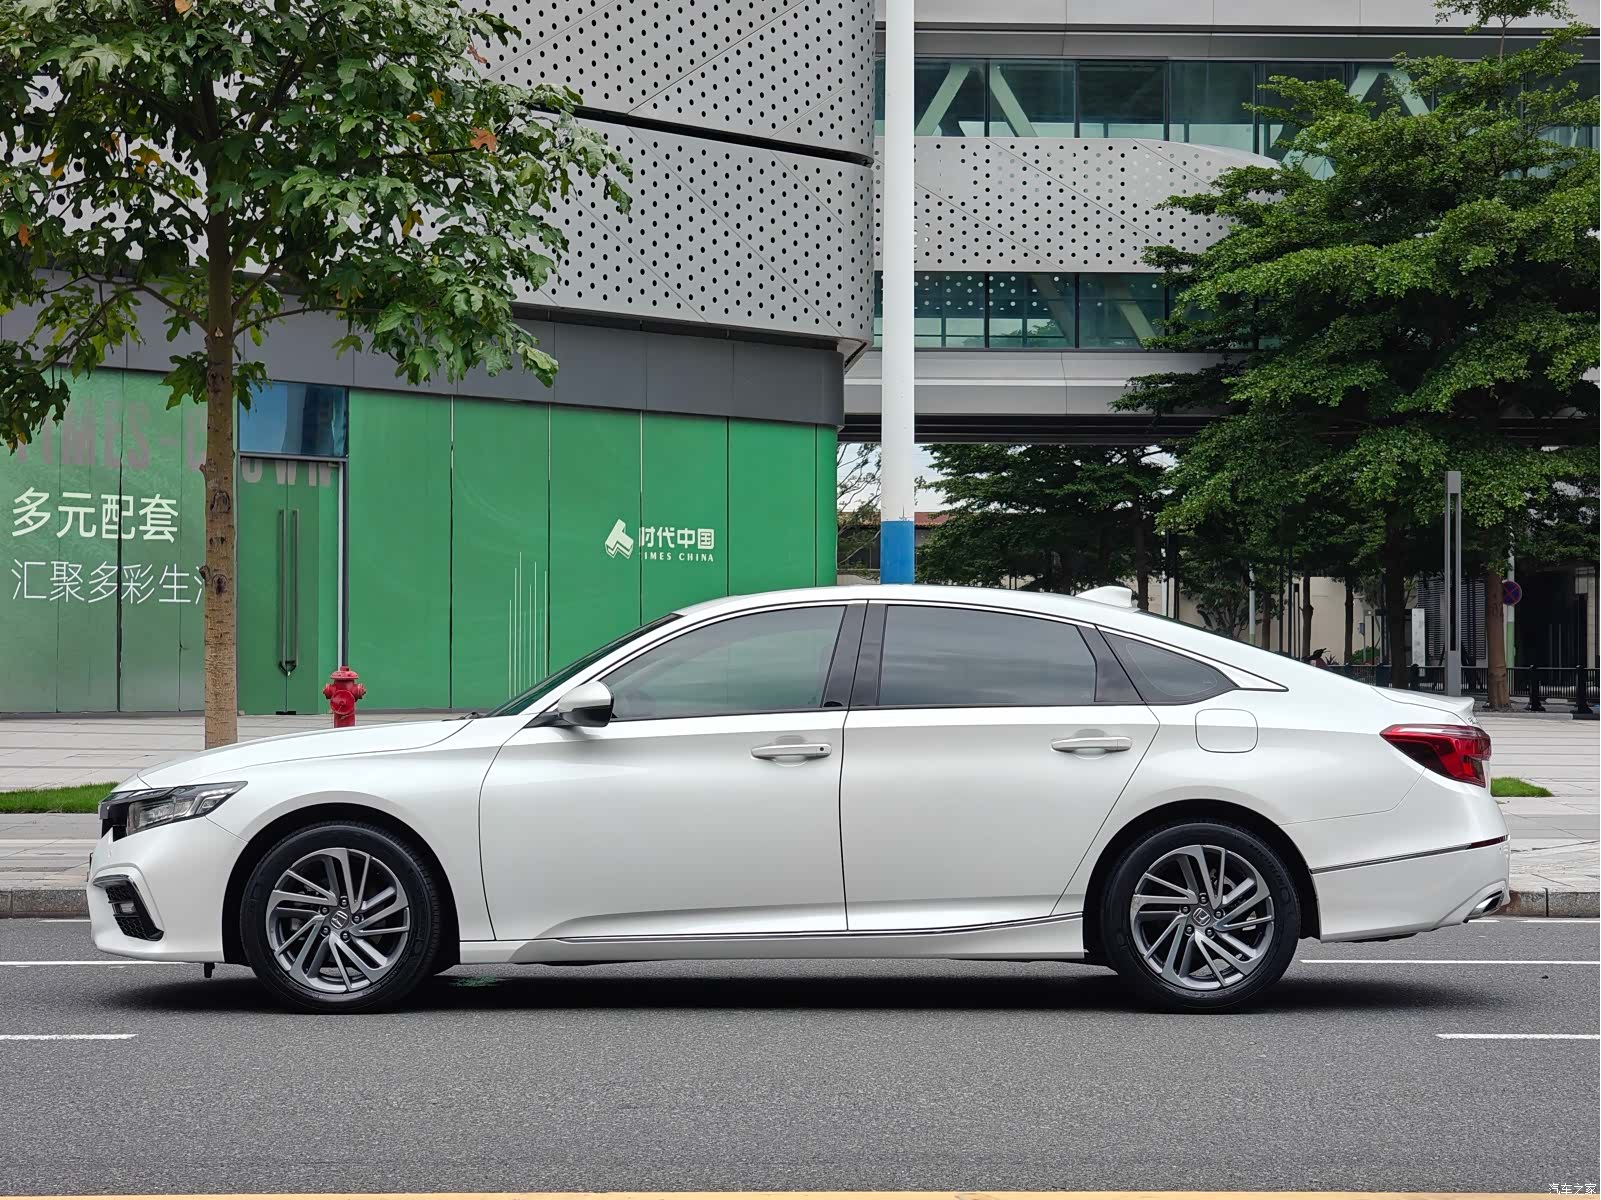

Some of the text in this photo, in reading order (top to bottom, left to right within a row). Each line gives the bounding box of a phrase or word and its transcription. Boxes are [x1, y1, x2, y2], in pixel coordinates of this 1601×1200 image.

[12, 487, 179, 543] 多元配套
[638, 526, 715, 549] 时代中国
[641, 552, 714, 562] IMES CHINA
